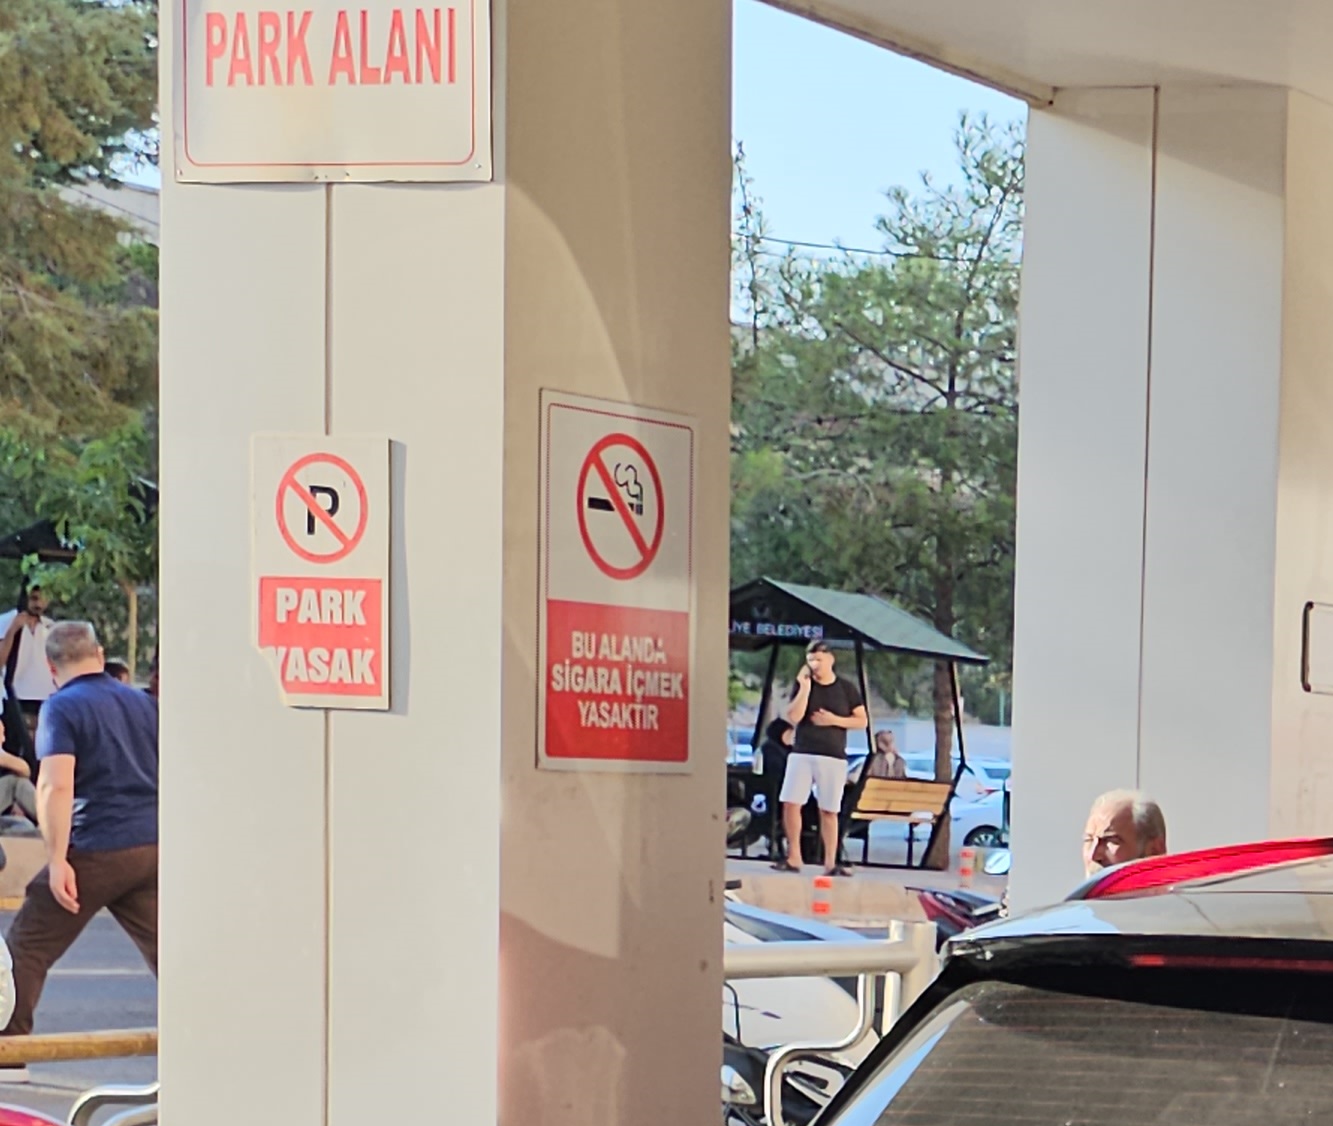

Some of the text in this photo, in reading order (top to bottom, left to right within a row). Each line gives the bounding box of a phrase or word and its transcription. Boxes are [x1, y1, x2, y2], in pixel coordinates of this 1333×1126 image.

[205, 8, 456, 87] PARK ALANI
[275, 587, 367, 626] PARK
[268, 645, 376, 685] YASAK
[571, 630, 668, 665] BU ALANDA
[551, 658, 685, 703] SİGARA İÇMEK
[577, 699, 659, 731] YASAKTIR
